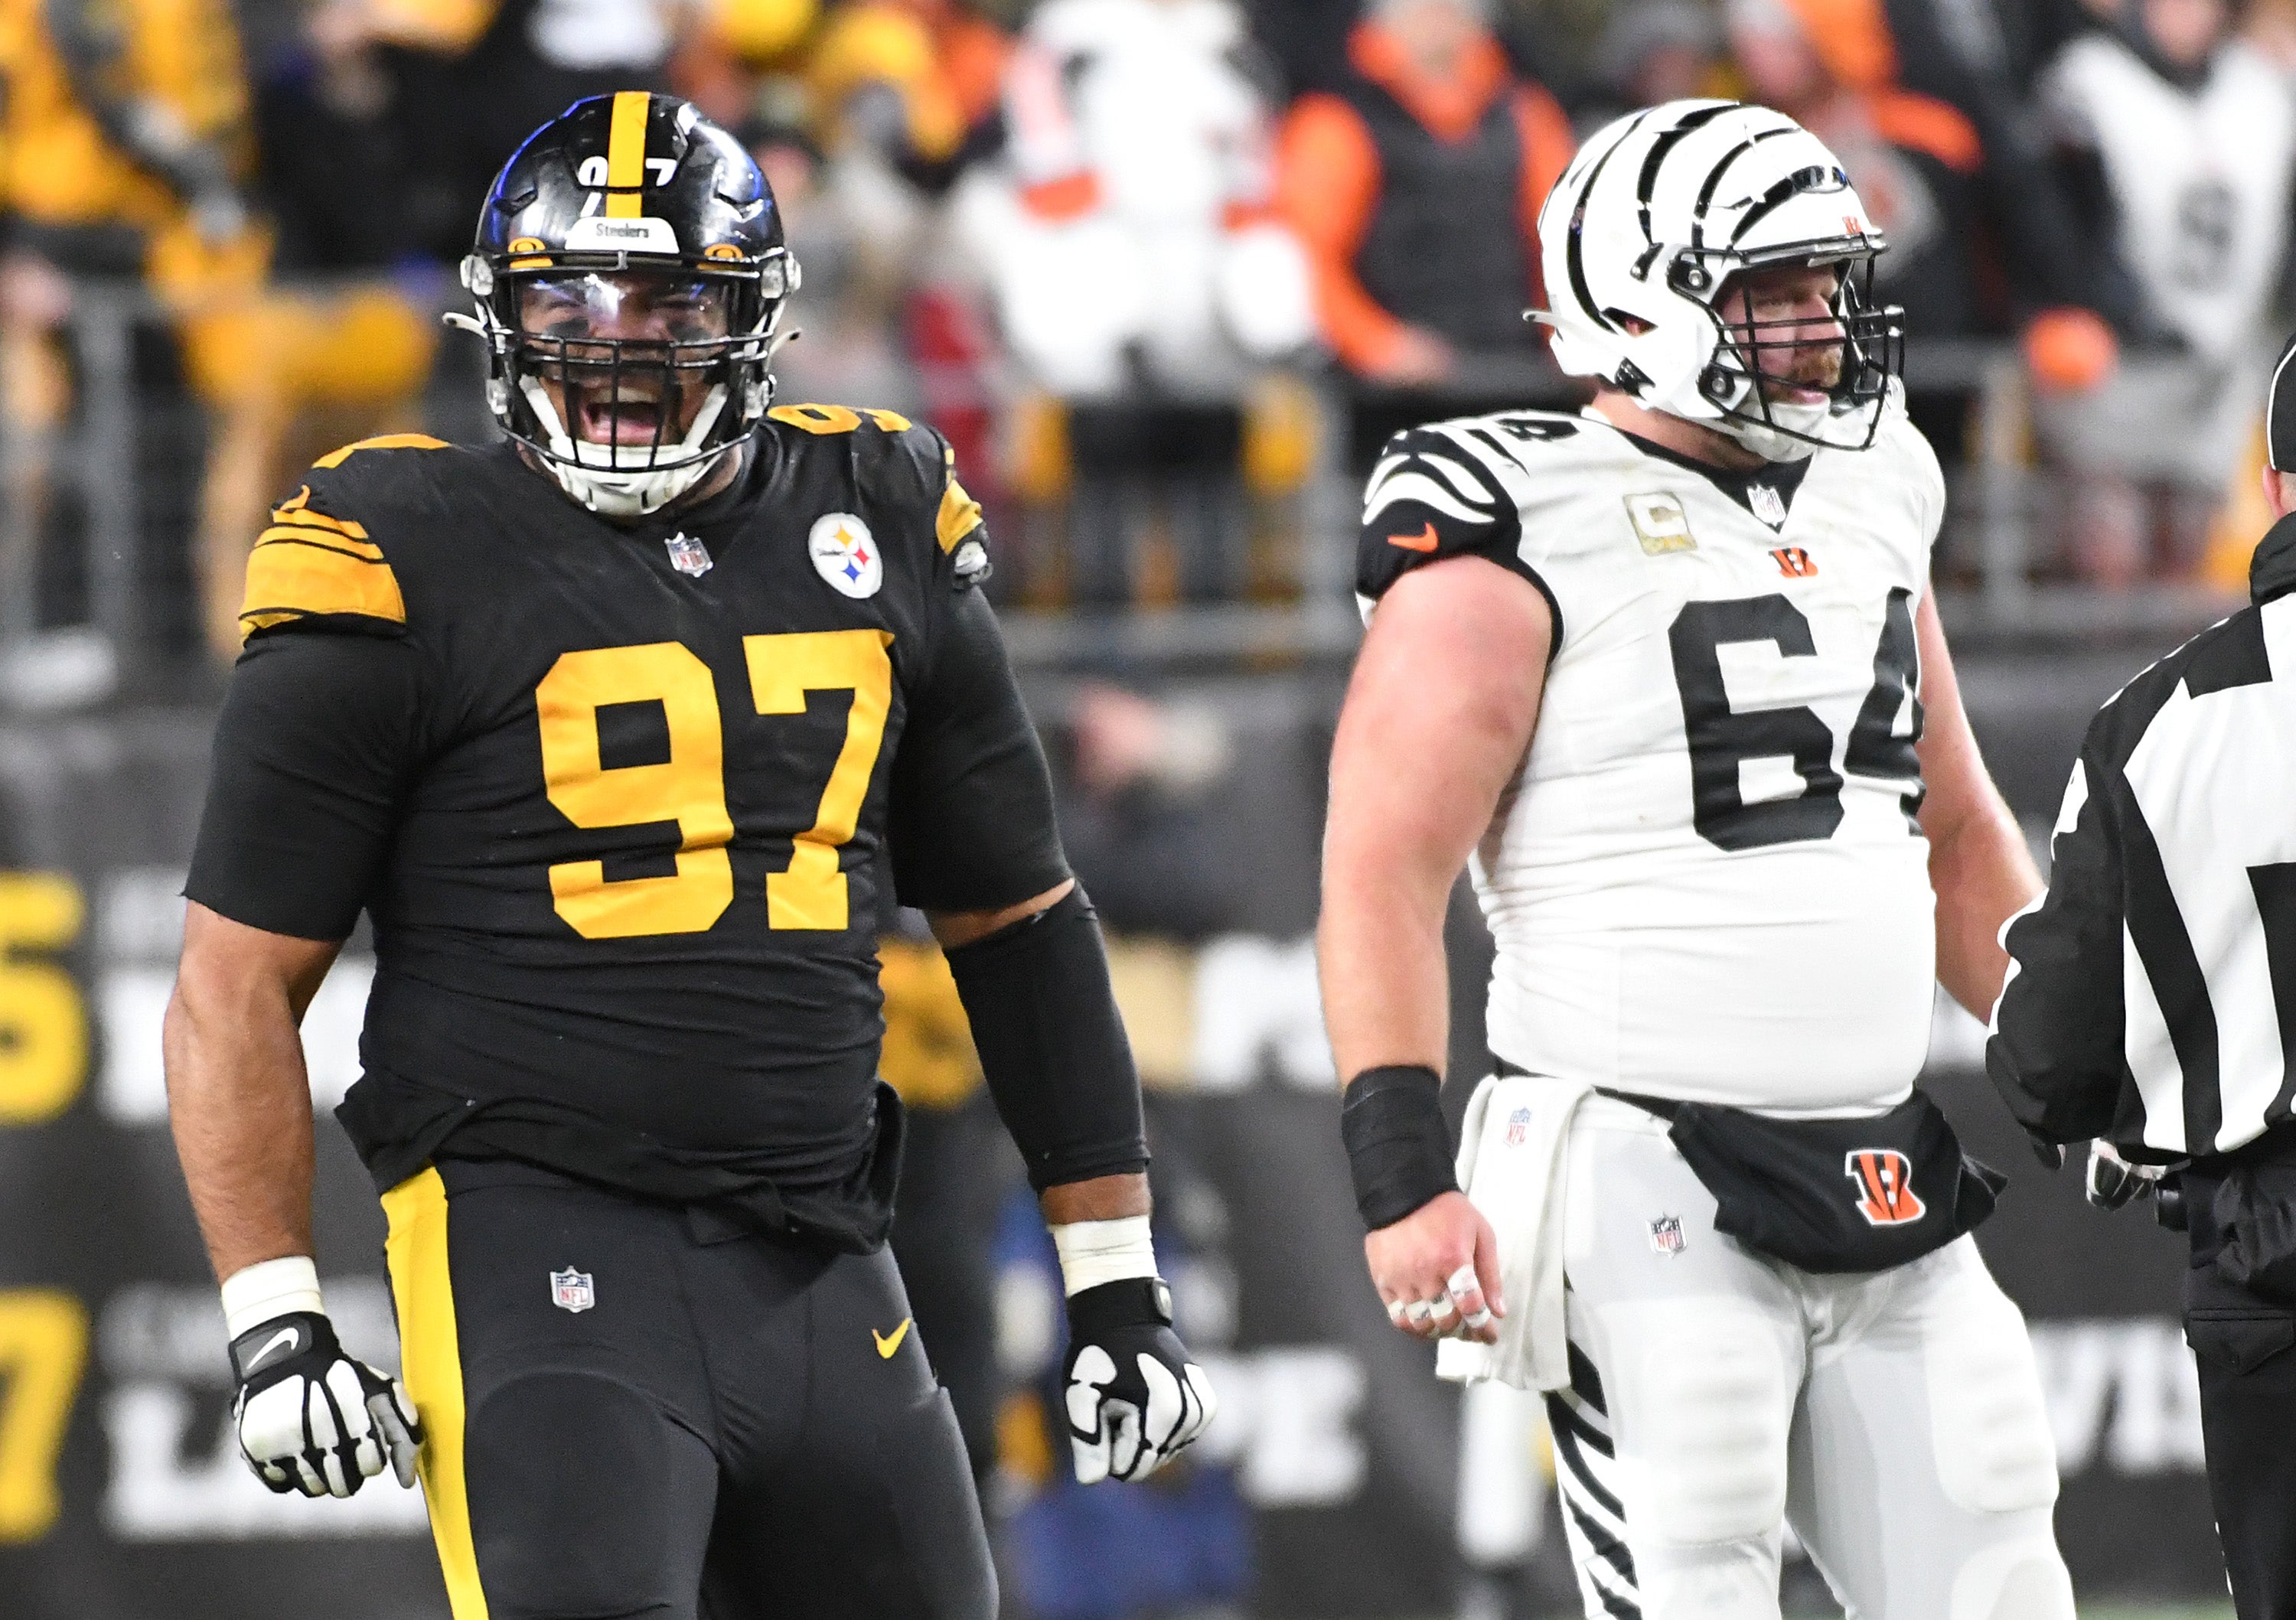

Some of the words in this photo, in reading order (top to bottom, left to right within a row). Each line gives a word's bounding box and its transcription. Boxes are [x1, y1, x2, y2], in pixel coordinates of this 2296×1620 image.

[595, 223, 650, 239] Steelers
[536, 629, 895, 938] 97
[1668, 586, 1924, 852] 64
